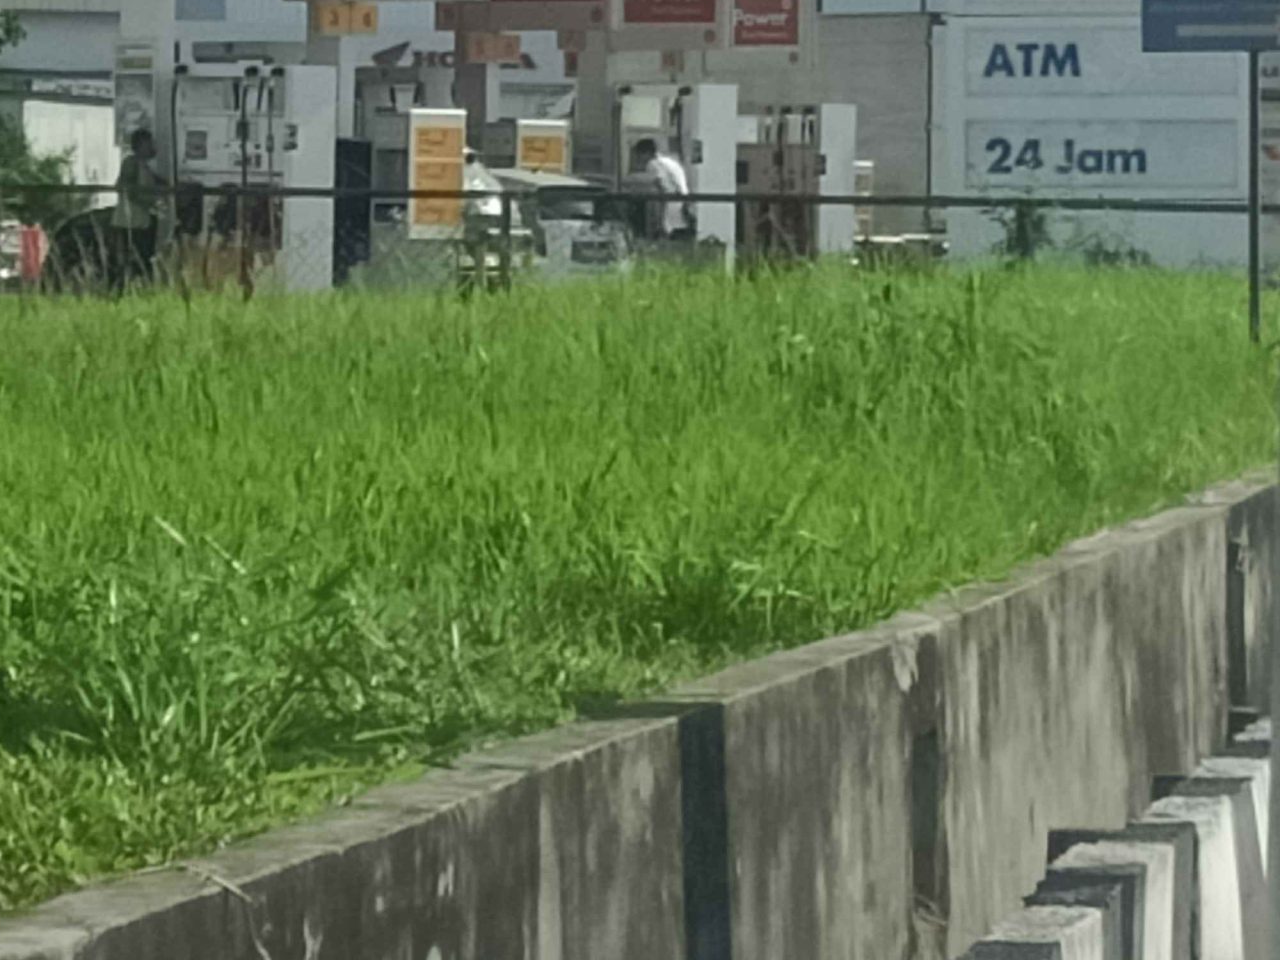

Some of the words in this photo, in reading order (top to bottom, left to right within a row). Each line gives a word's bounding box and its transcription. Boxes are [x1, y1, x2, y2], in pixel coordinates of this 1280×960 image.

[983, 43, 1081, 77] ATM
[985, 137, 1044, 173] 24
[1055, 138, 1147, 173] Jam
